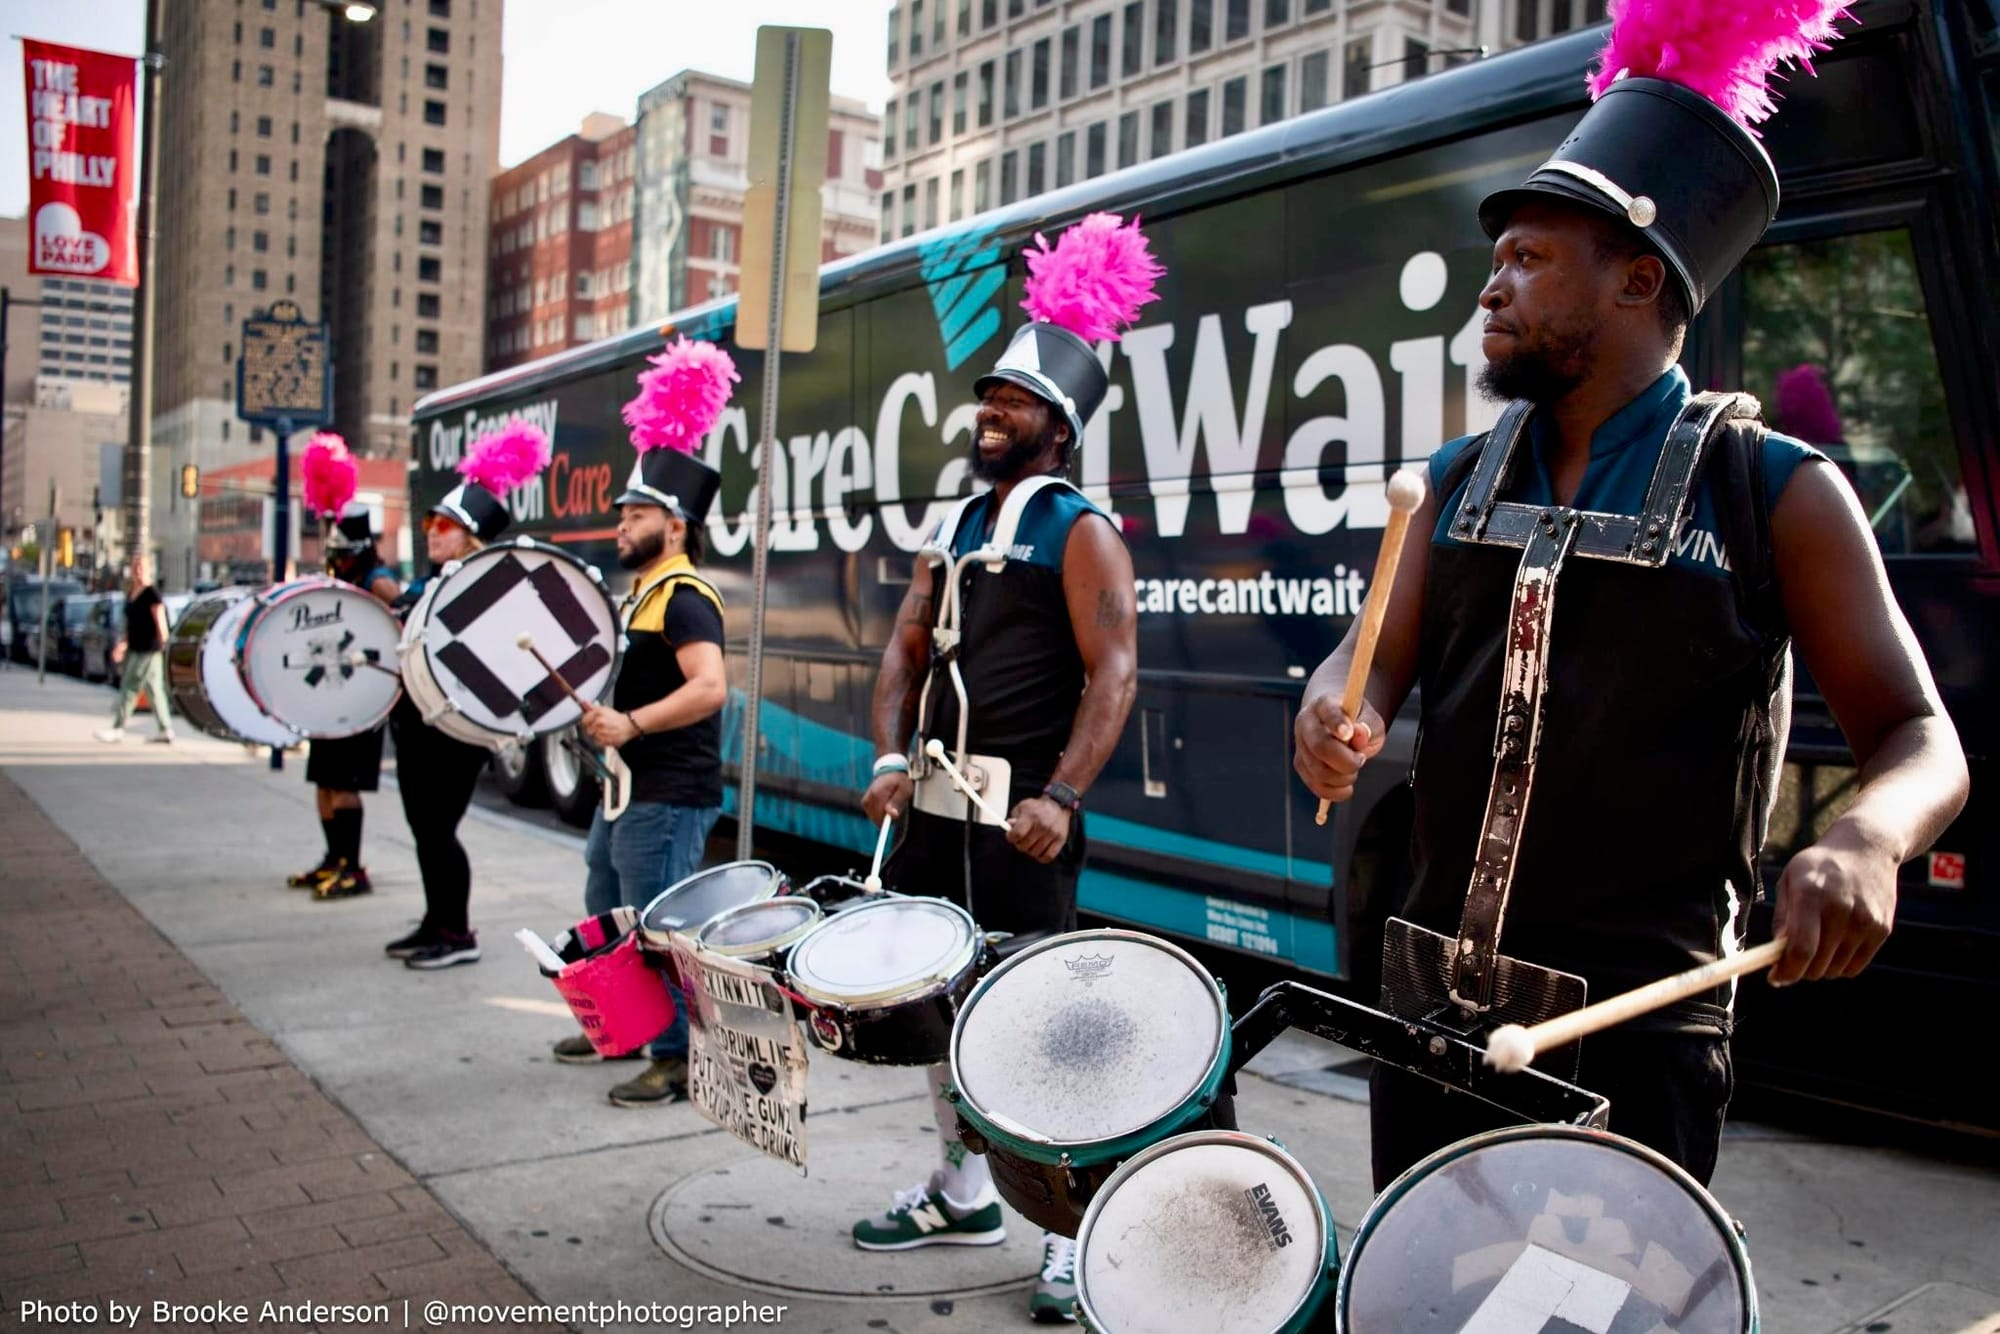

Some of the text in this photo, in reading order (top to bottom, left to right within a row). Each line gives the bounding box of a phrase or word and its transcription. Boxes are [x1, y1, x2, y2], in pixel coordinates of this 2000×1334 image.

[31, 59, 79, 95] THE
[32, 89, 112, 128] HEART
[33, 120, 67, 151] OF
[34, 150, 116, 188] PHILLY
[41, 235, 95, 250] LOVE
[41, 251, 97, 267] PARK
[429, 418, 463, 471] Our
[549, 452, 612, 519] Care
[287, 600, 343, 632] Pearl
[694, 1049, 713, 1083] PUT
[1251, 1182, 1293, 1248] EVANS
